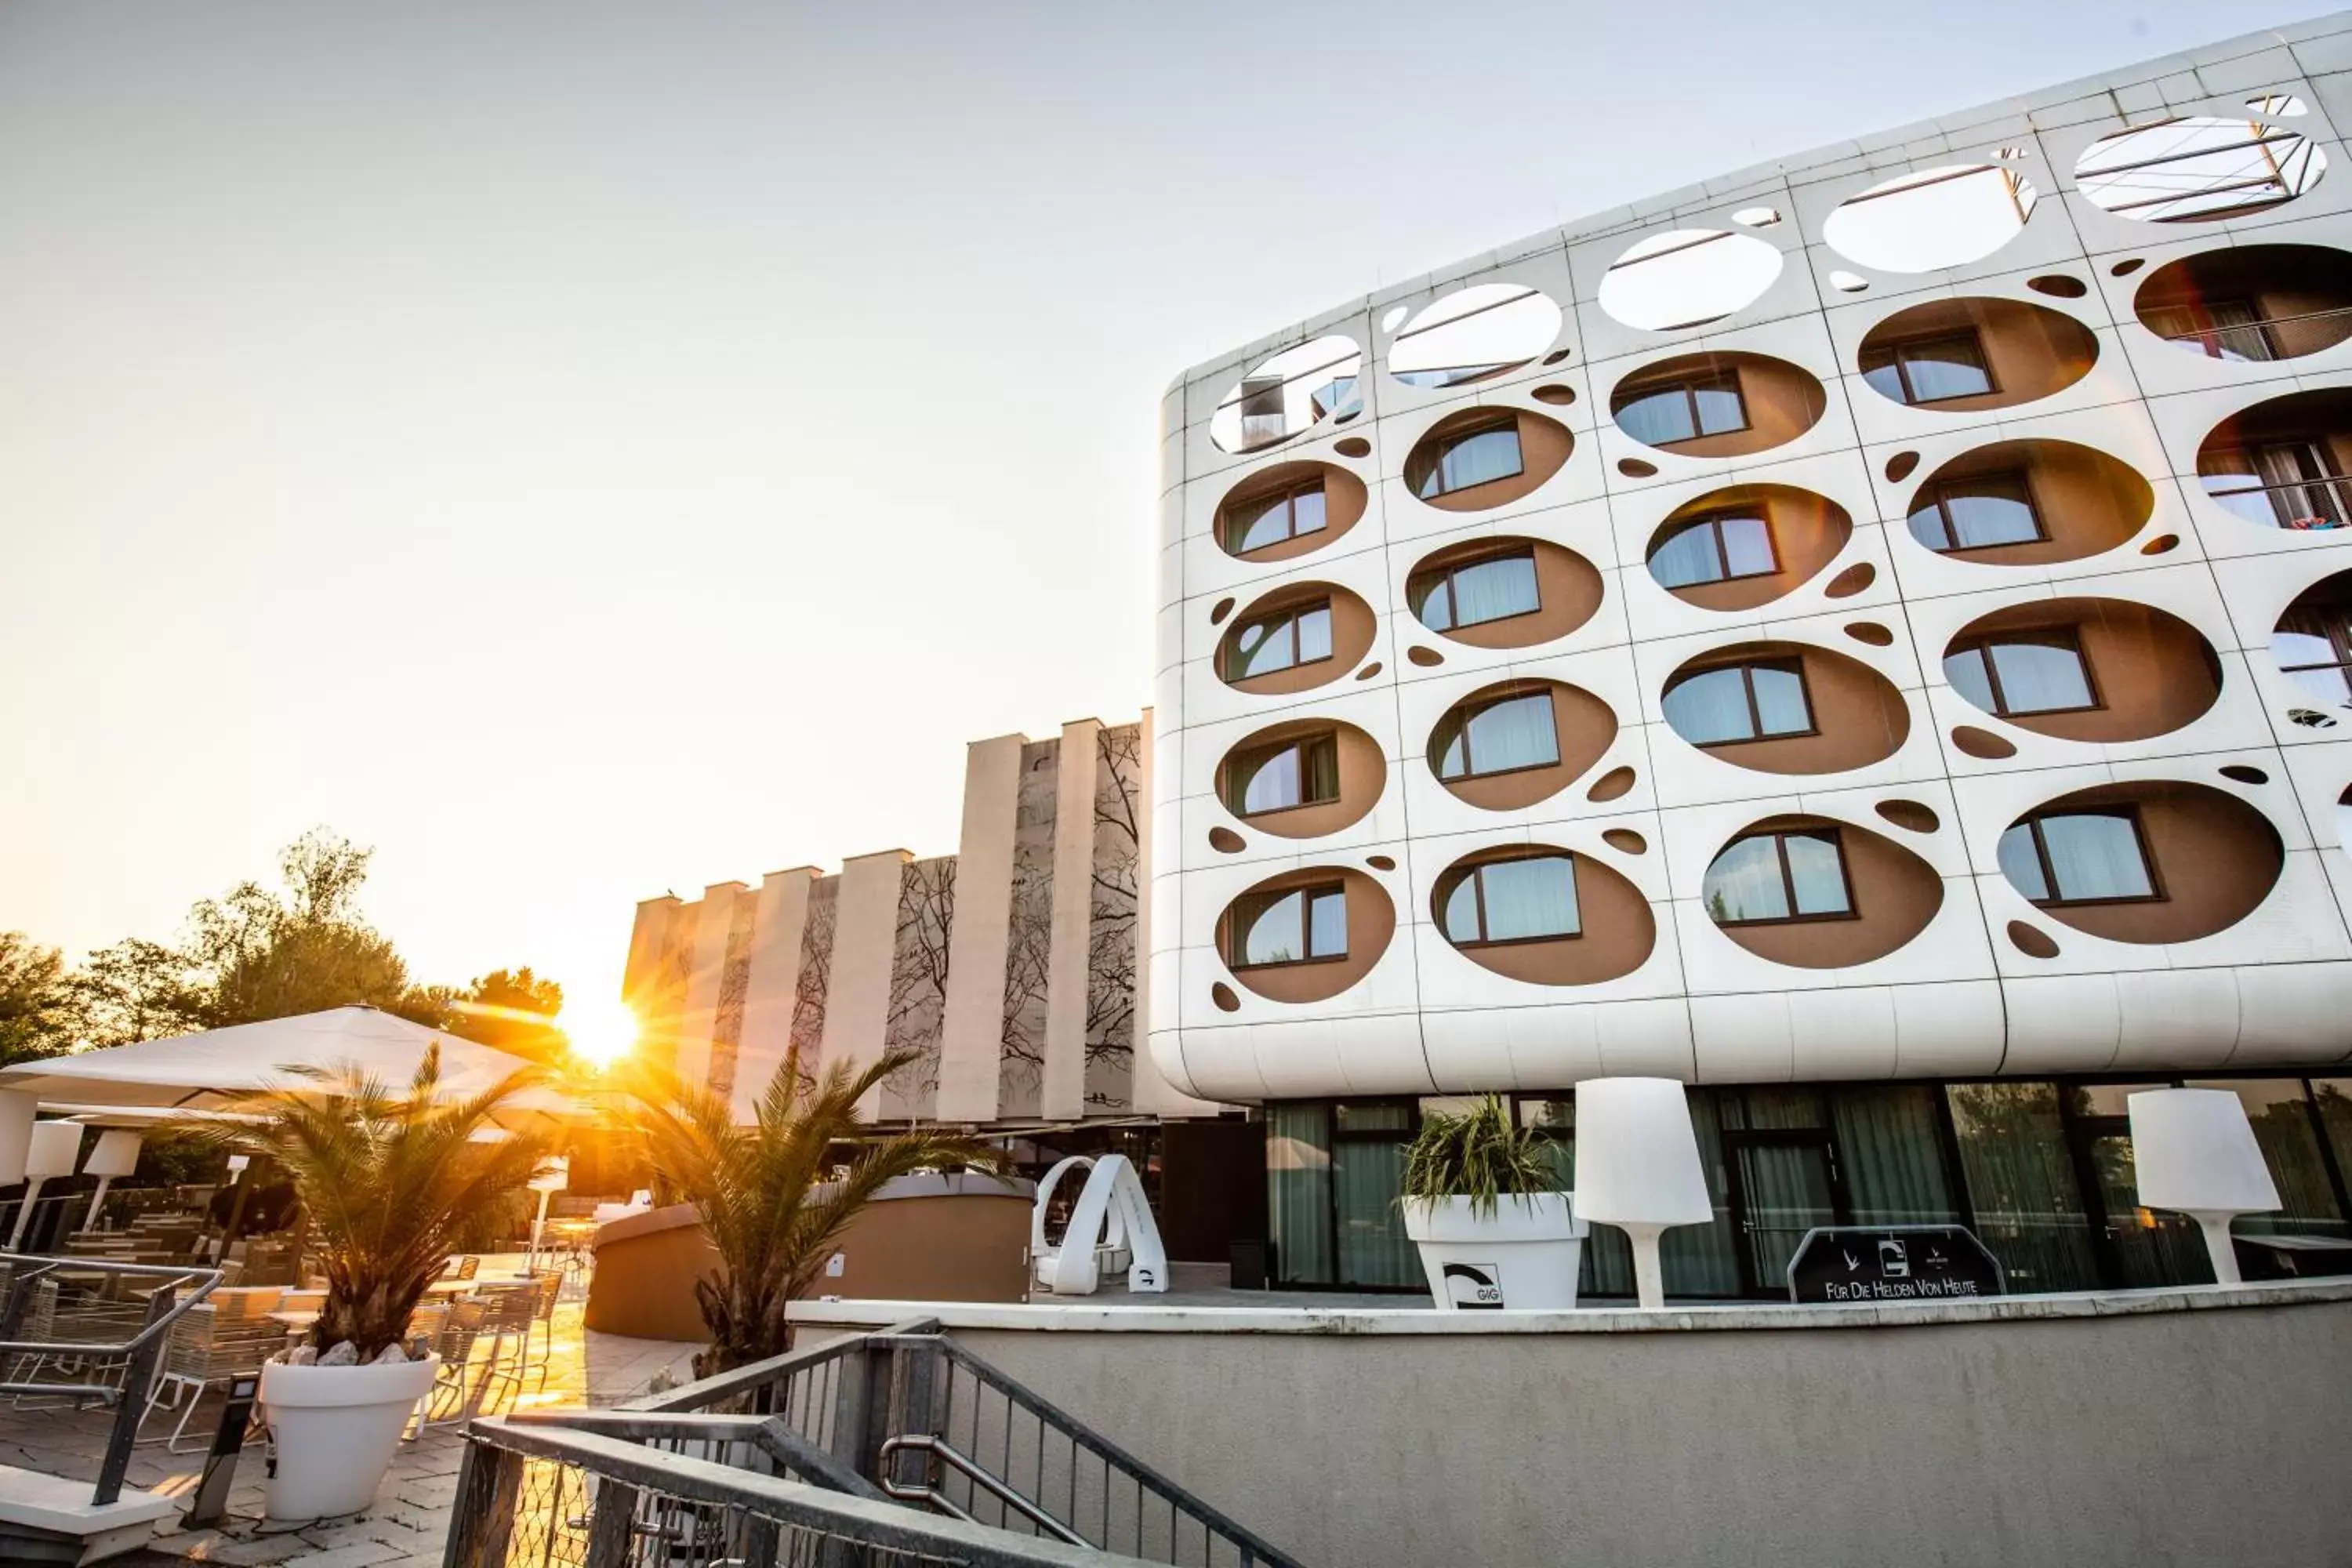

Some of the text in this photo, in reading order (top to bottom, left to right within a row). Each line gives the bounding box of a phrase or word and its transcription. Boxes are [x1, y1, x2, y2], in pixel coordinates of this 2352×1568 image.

[1826, 1277, 1977, 1300] FÜR DIE HELDEN VON HEUTE
